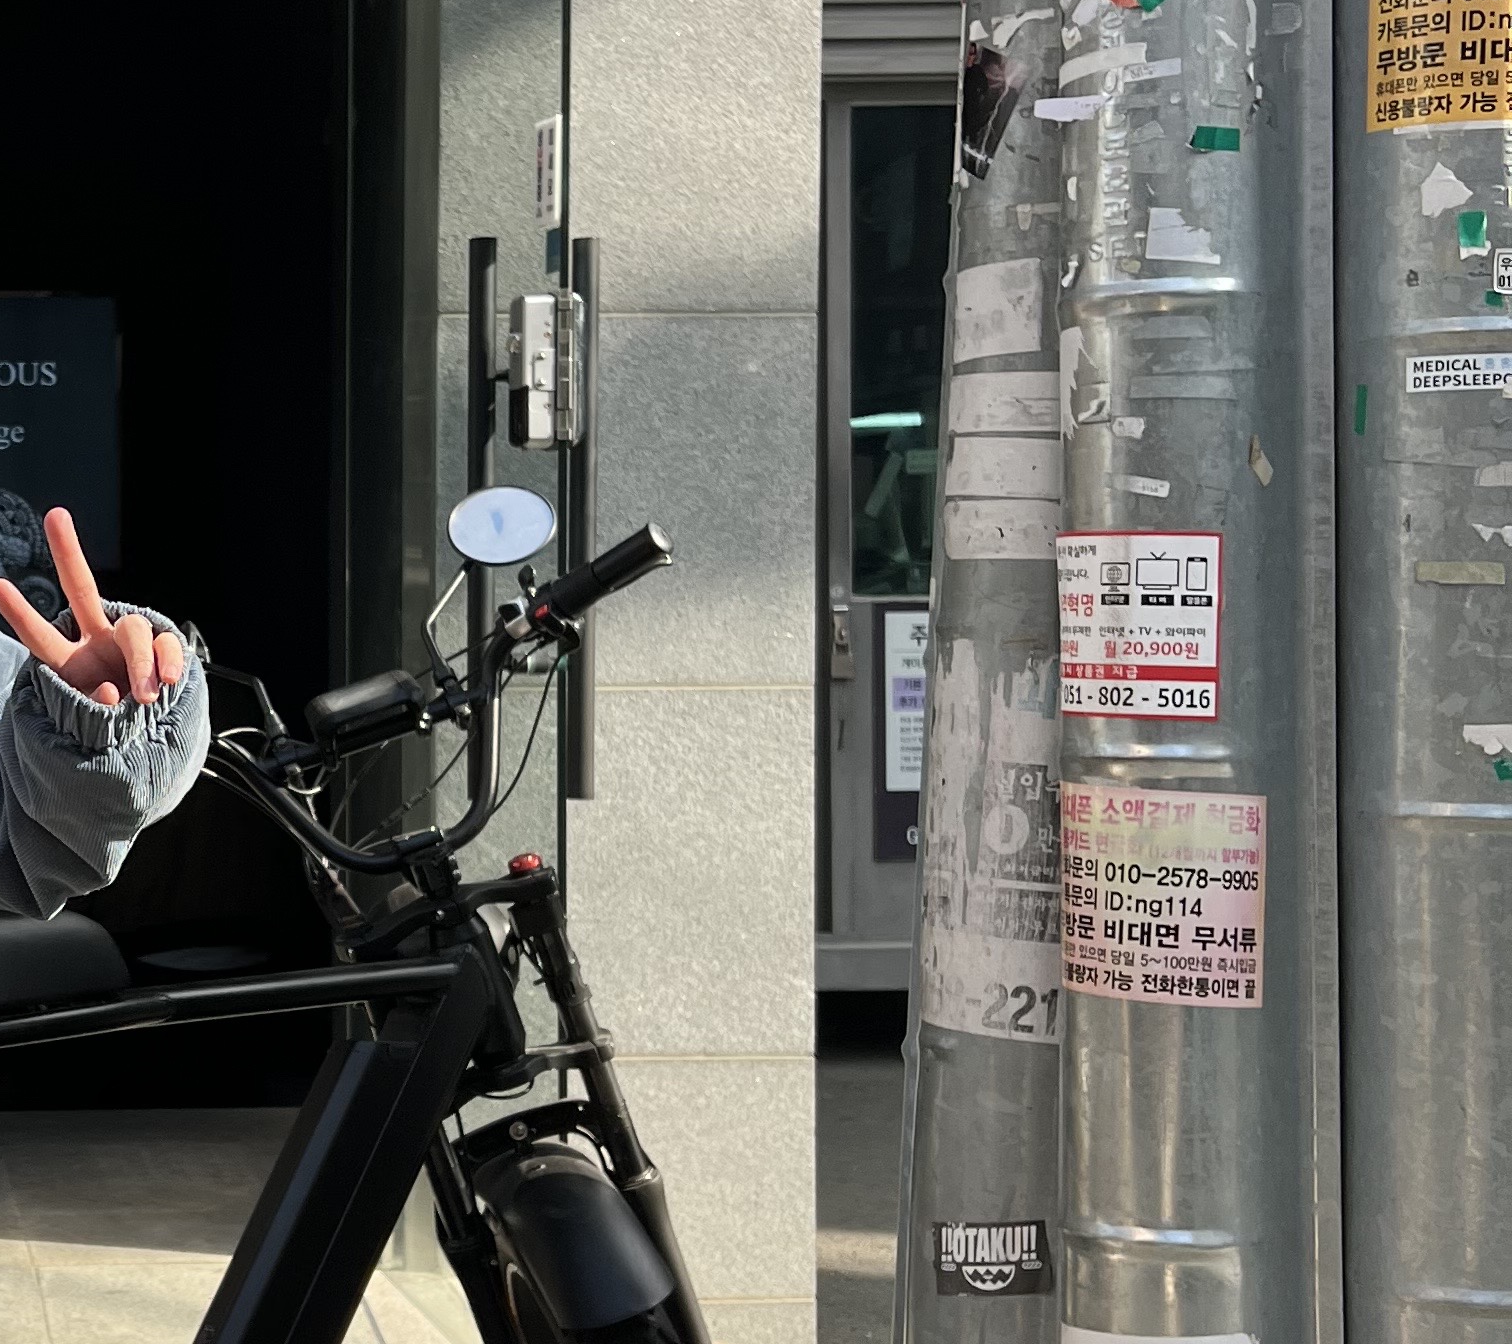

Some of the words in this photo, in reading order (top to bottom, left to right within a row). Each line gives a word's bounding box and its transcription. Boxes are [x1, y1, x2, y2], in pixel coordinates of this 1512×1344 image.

[1377, 11, 1451, 43] 카톡문의
[1376, 41, 1447, 75] 무방문
[1423, 71, 1464, 89] 있으면
[1470, 69, 1500, 86] 당일
[1375, 94, 1452, 123] 신용불량자
[1460, 92, 1498, 114] 가능
[1413, 358, 1482, 374] MEDICAL
[1139, 626, 1152, 636] TV
[1123, 641, 1199, 660] 20,900원
[1063, 684, 1082, 705] 051
[1098, 686, 1134, 706] 802
[1157, 688, 1211, 709] 5016
[1062, 791, 1093, 825] 대폰
[1105, 862, 1259, 891] 010-2578-9905
[1105, 891, 1203, 918] ID:ng114
[1062, 910, 1096, 940] 방문
[1104, 919, 1180, 949] 비대면
[1192, 926, 1257, 953] 무서류
[1110, 950, 1135, 966] 당일
[1217, 958, 1257, 974] 즉시입금
[1103, 969, 1134, 992] 가능
[1141, 973, 1239, 998] 전화한통이면
[1245, 979, 1256, 999] 끝
